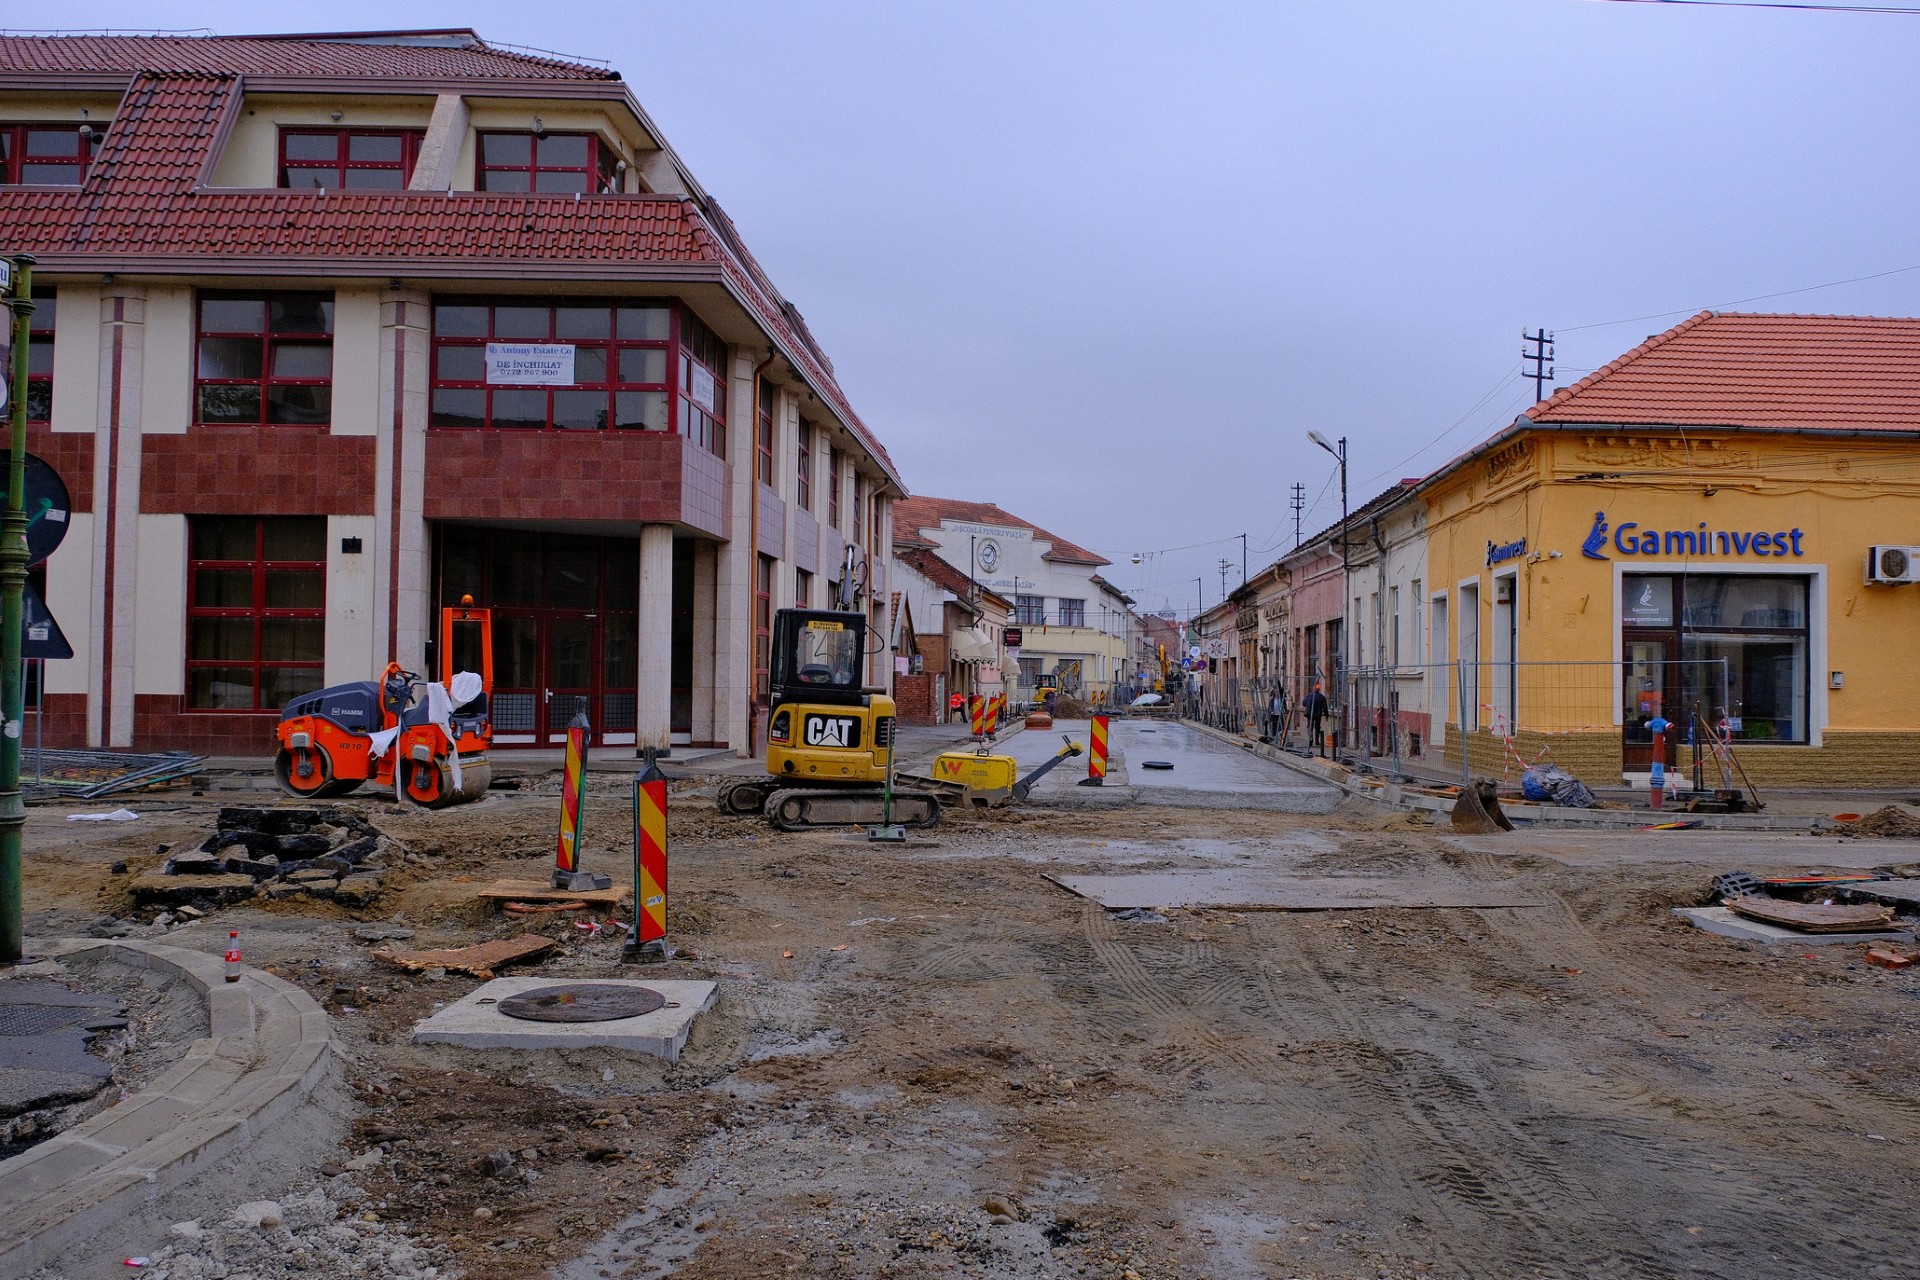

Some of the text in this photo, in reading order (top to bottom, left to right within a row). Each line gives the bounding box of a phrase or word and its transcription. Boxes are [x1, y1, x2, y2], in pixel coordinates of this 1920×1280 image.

[500, 346, 572, 356] Antony Estate Co
[496, 360, 563, 369] DE ÎNCHIRIAT
[1491, 537, 1527, 563] Gaminvest
[1614, 522, 1804, 556] Gaminvest
[807, 717, 853, 747] CAT
